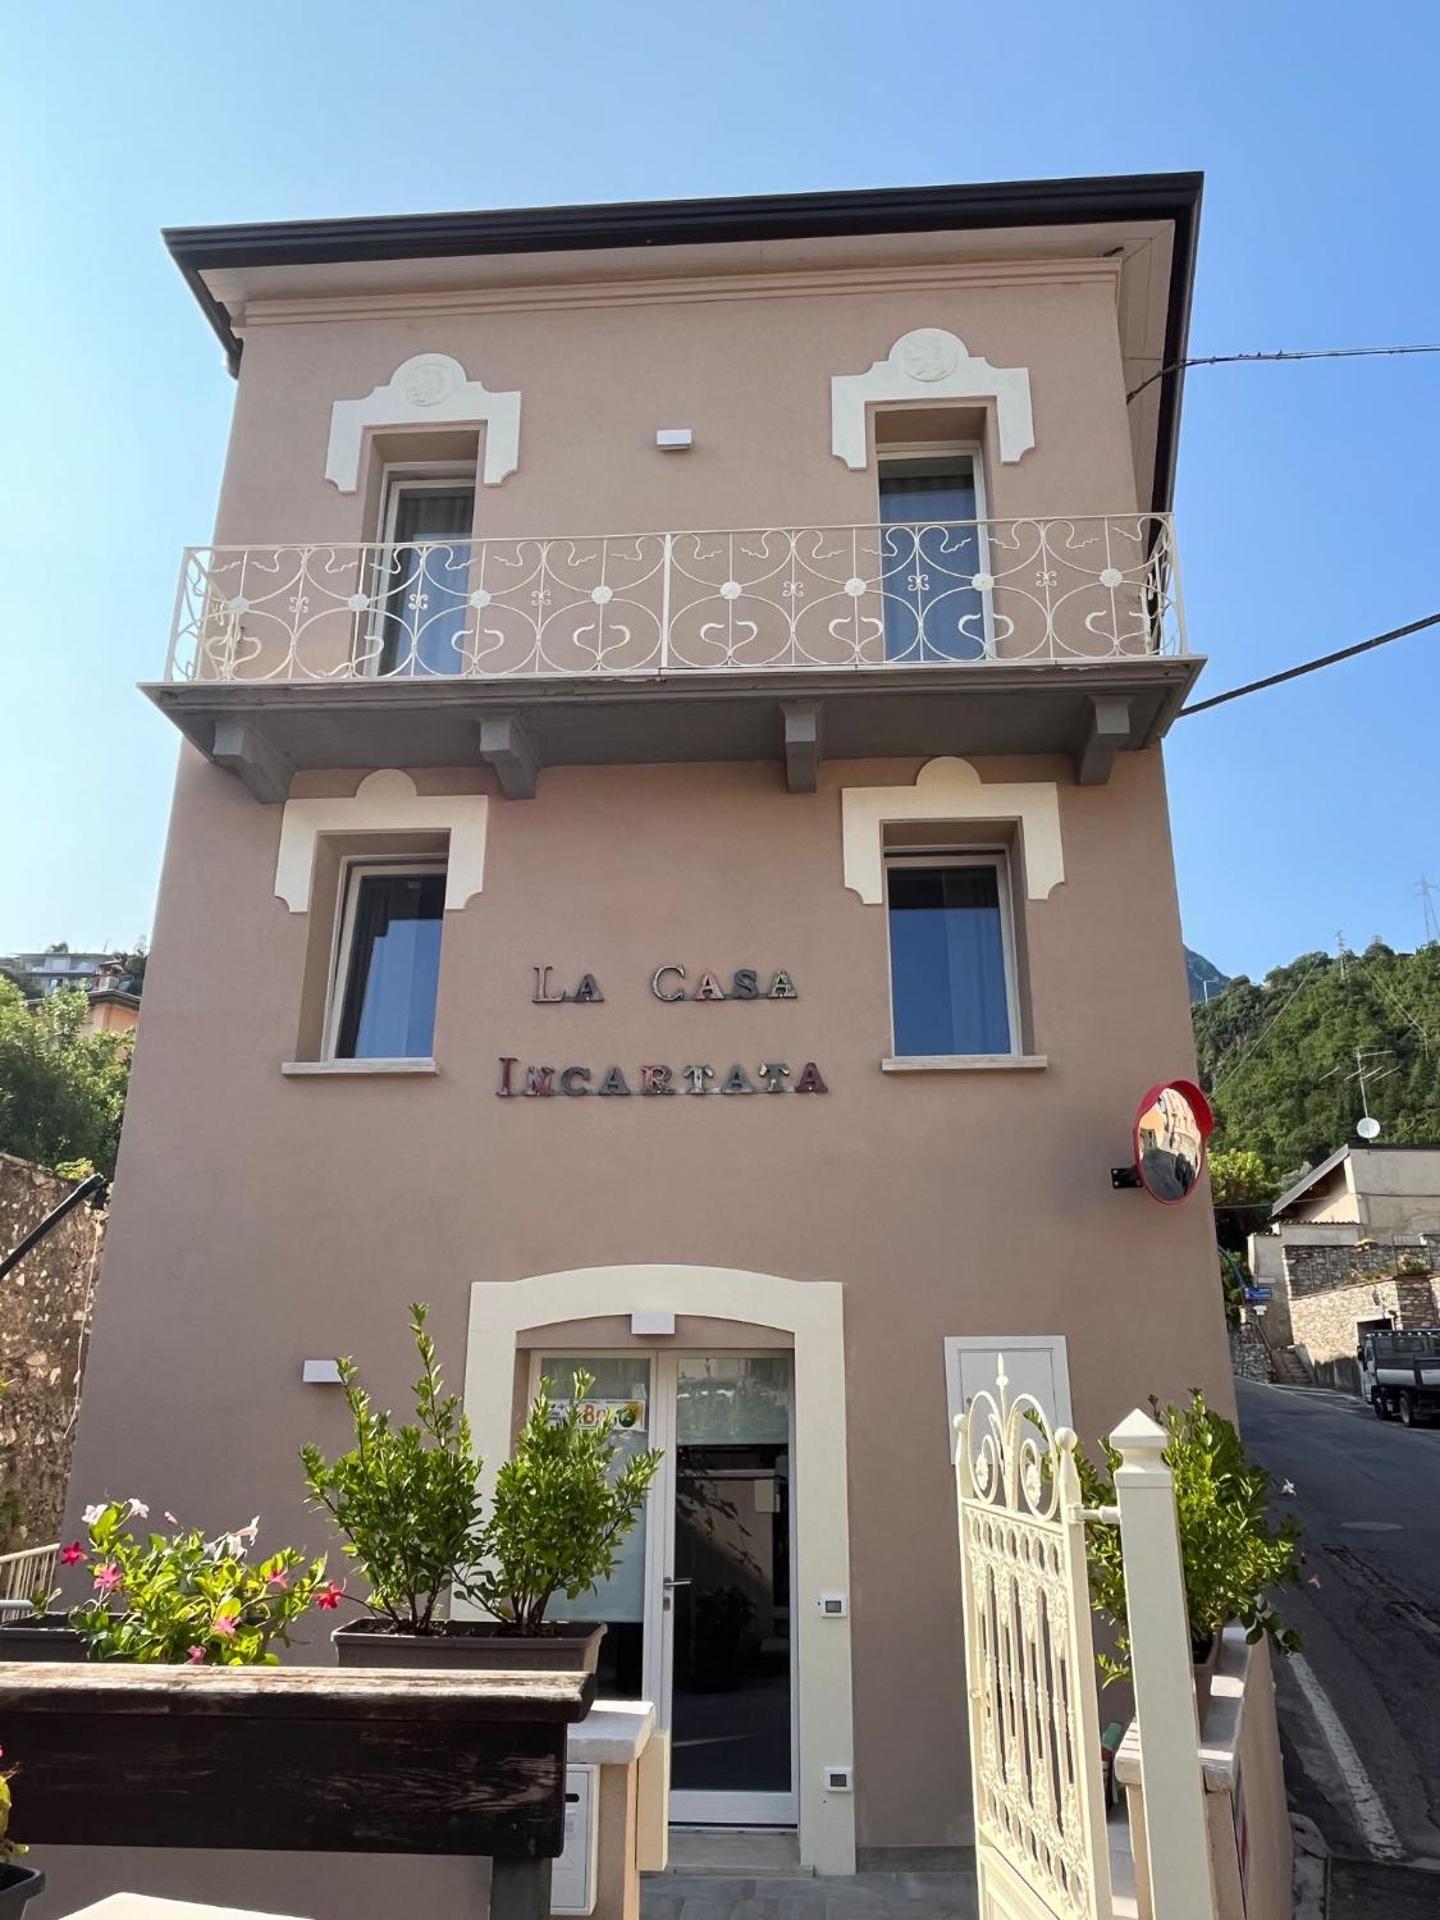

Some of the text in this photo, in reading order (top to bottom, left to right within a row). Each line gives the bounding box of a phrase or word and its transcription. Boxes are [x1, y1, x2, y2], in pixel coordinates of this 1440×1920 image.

[532, 965, 799, 1004] LA CASA
[497, 1057, 829, 1098] INCARTATA
